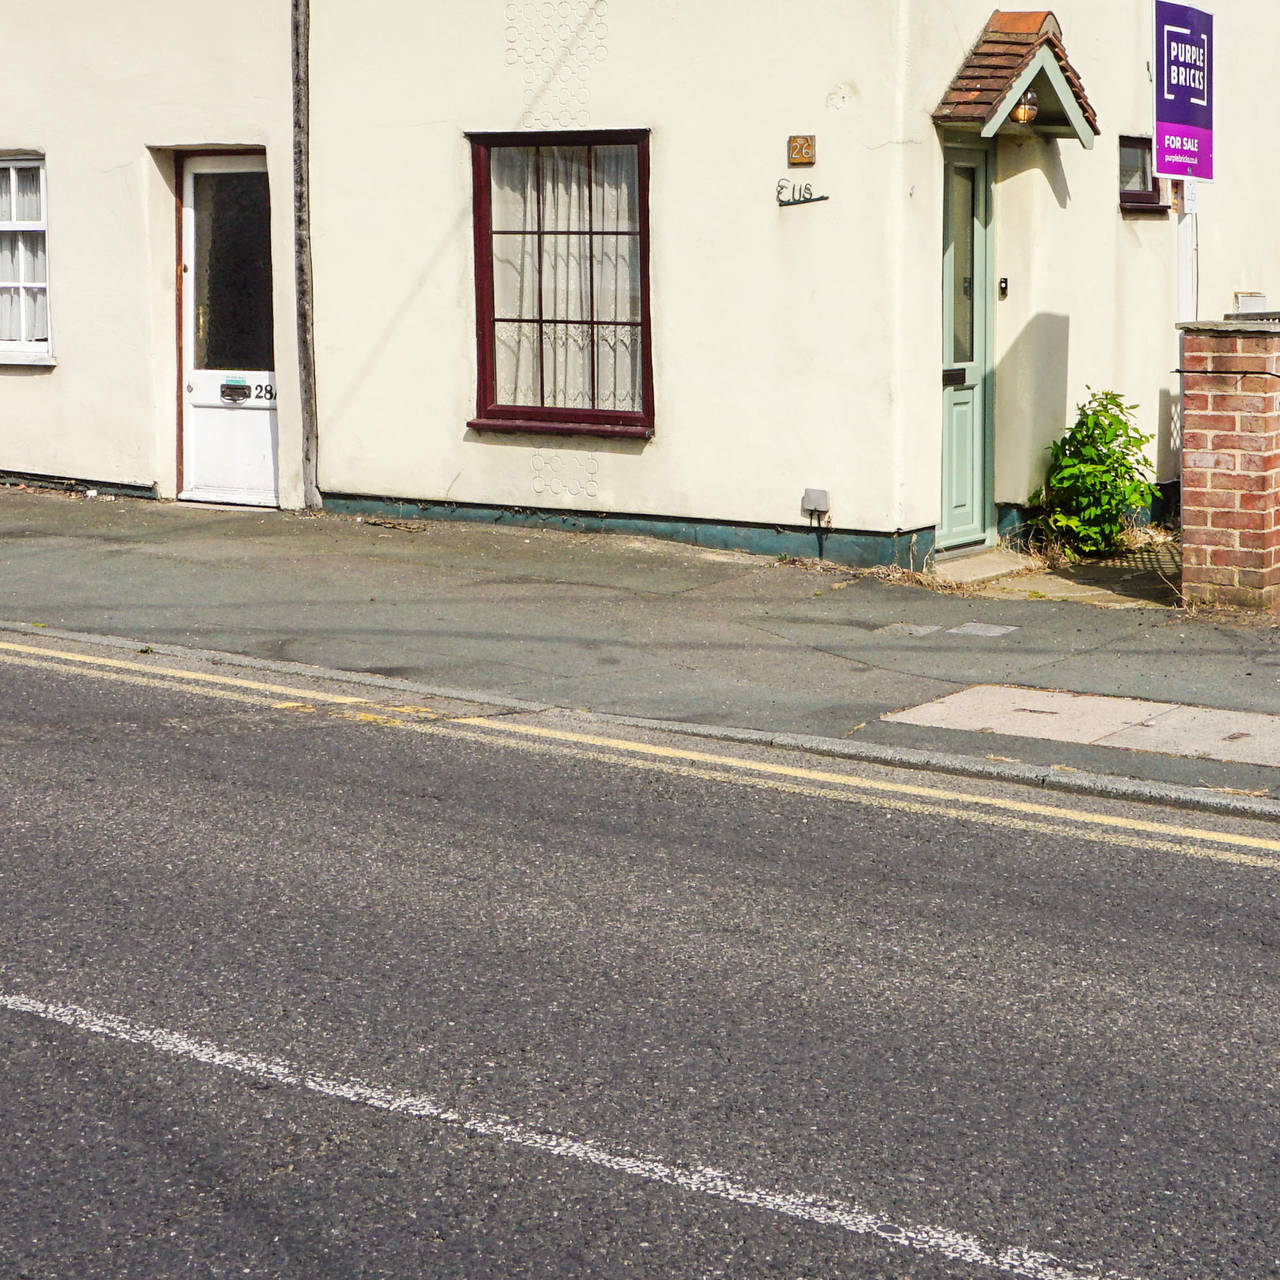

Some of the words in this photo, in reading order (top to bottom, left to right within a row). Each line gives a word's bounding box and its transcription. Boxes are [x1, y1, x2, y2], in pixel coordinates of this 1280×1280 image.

[1170, 41, 1204, 68] PURPLE
[1170, 65, 1204, 90] BRICKS
[791, 142, 810, 159] 26
[1164, 135, 1182, 149] FOR
[1182, 137, 1199, 152] SALE
